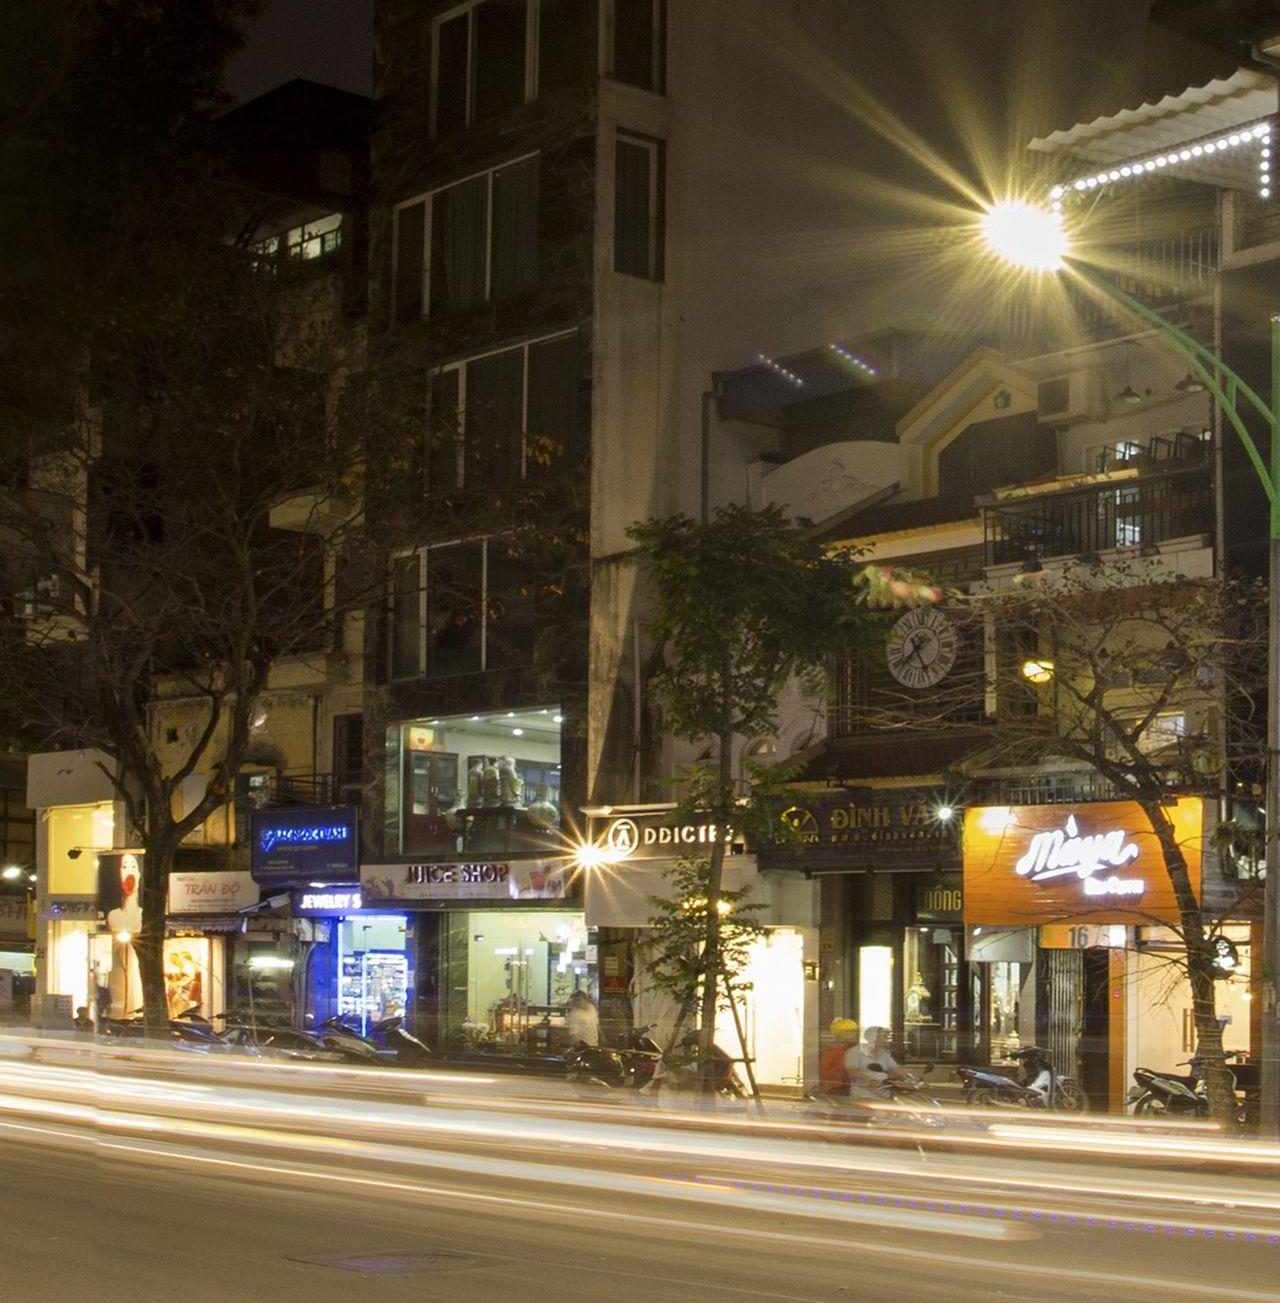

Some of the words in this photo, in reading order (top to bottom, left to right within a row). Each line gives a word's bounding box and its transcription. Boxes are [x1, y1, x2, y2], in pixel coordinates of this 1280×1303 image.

[831, 802, 890, 829] ĐÌNH
[405, 864, 456, 884] JUICE
[460, 863, 509, 883] SHOP
[300, 893, 351, 909] JEWELRY
[1070, 926, 1089, 947] 16
